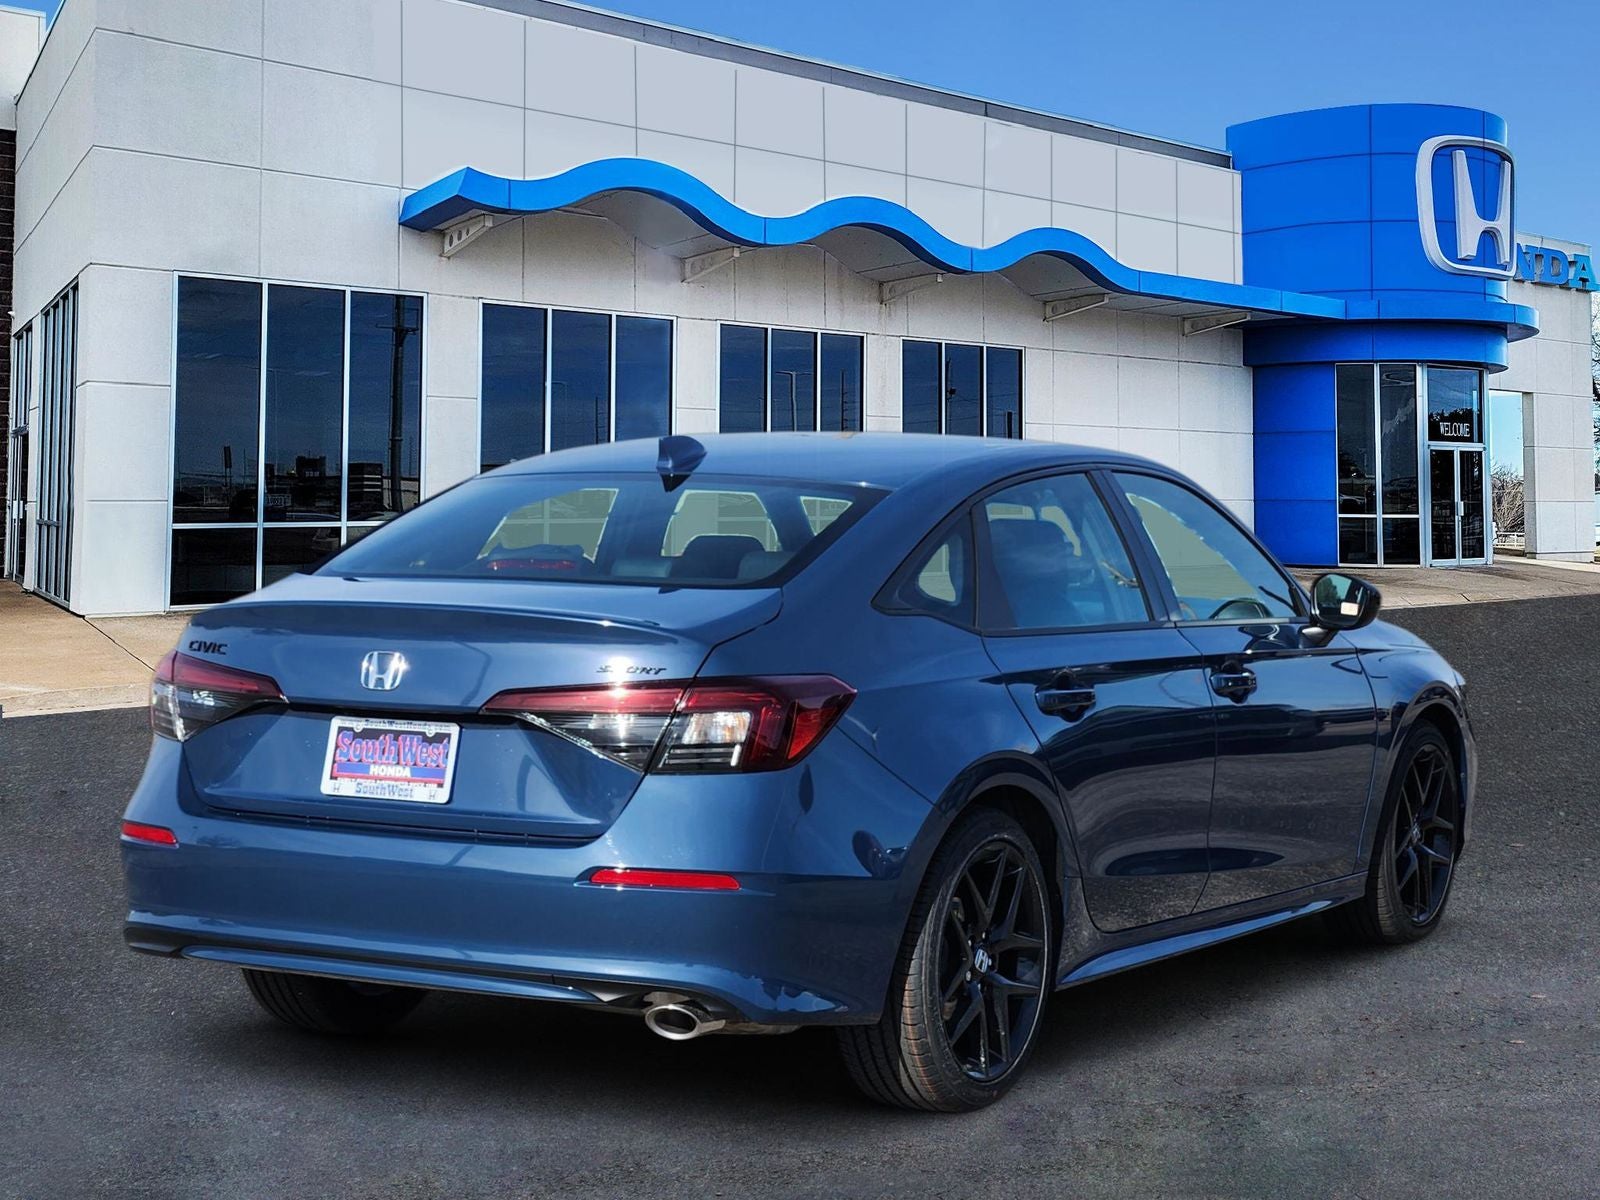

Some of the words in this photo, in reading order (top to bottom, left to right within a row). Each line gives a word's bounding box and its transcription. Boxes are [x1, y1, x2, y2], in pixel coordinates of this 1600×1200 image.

[1517, 244, 1600, 292] NDA
[1439, 422, 1470, 437] WELCOME
[189, 640, 228, 655] CIVIC
[595, 664, 667, 675] SORT
[369, 765, 411, 777] HONDA
